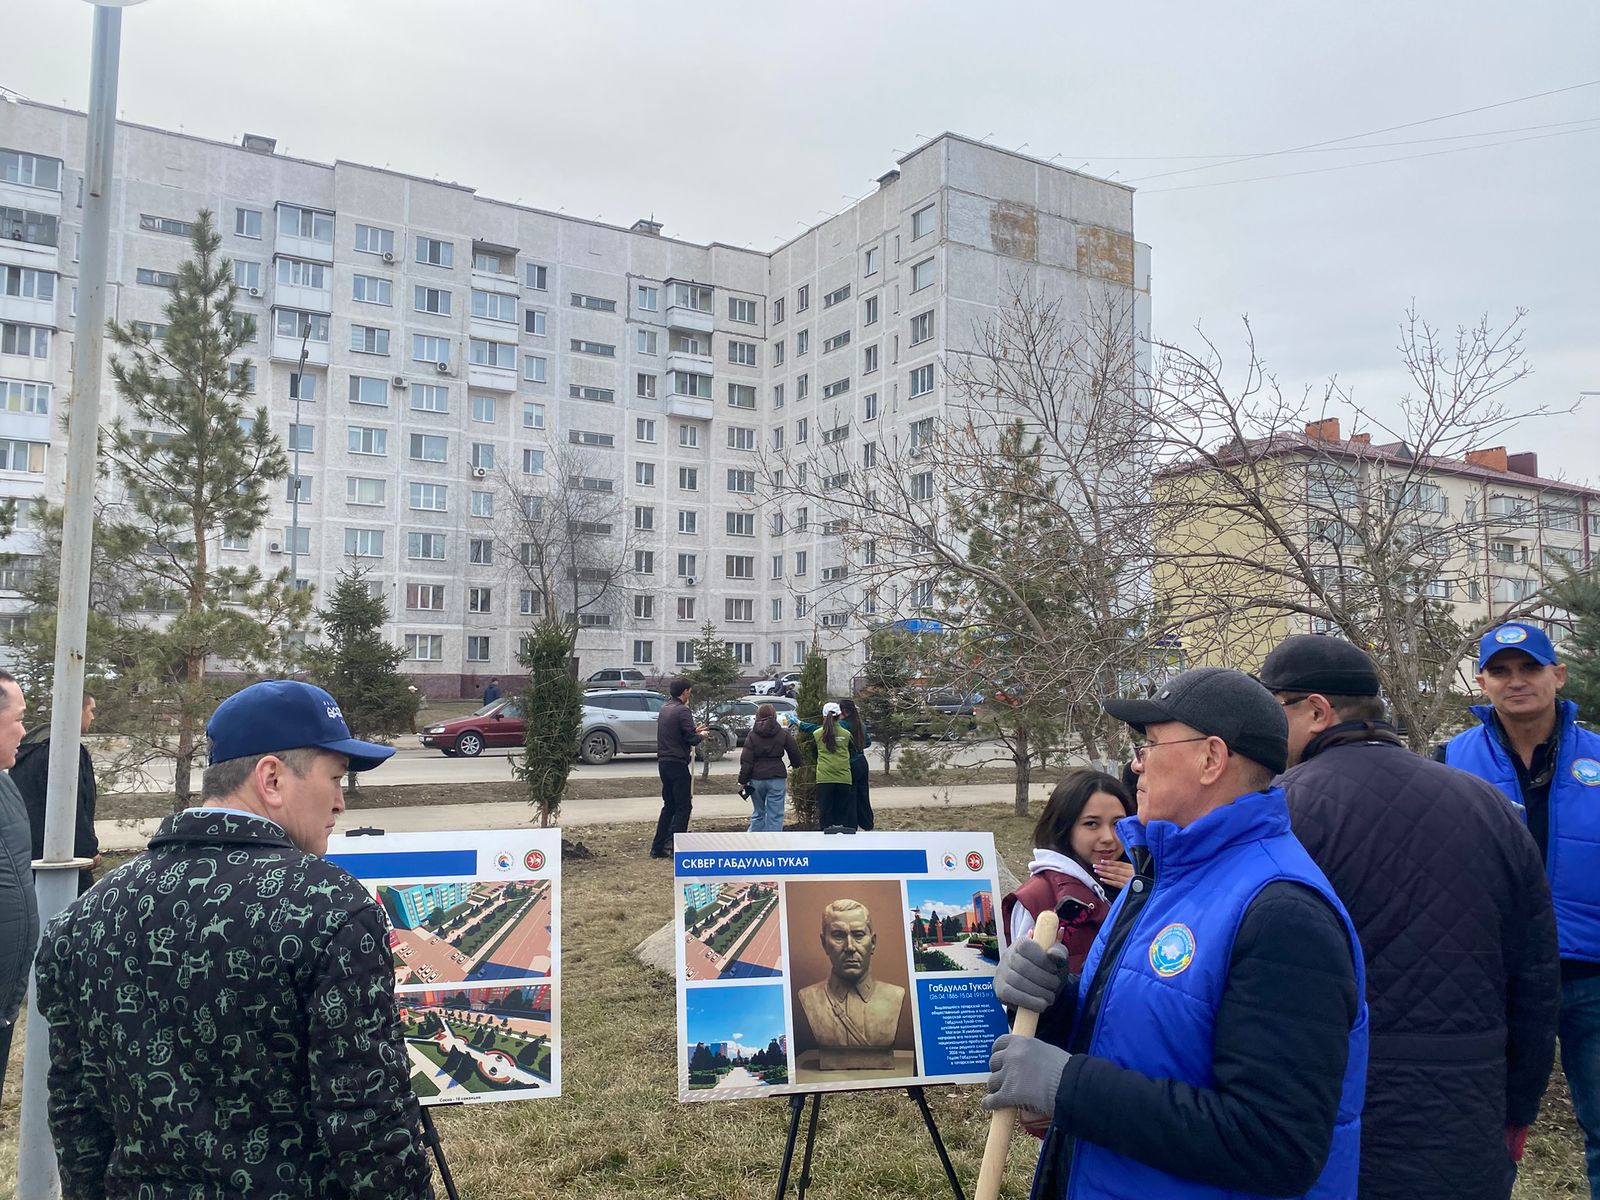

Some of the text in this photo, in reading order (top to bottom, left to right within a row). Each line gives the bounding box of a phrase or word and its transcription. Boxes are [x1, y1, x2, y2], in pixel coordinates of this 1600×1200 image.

[682, 856, 809, 870] СКВЕР ГАБДУЛЛЫ ТУКАЯ
[929, 982, 993, 992] Габдулла Тукай
